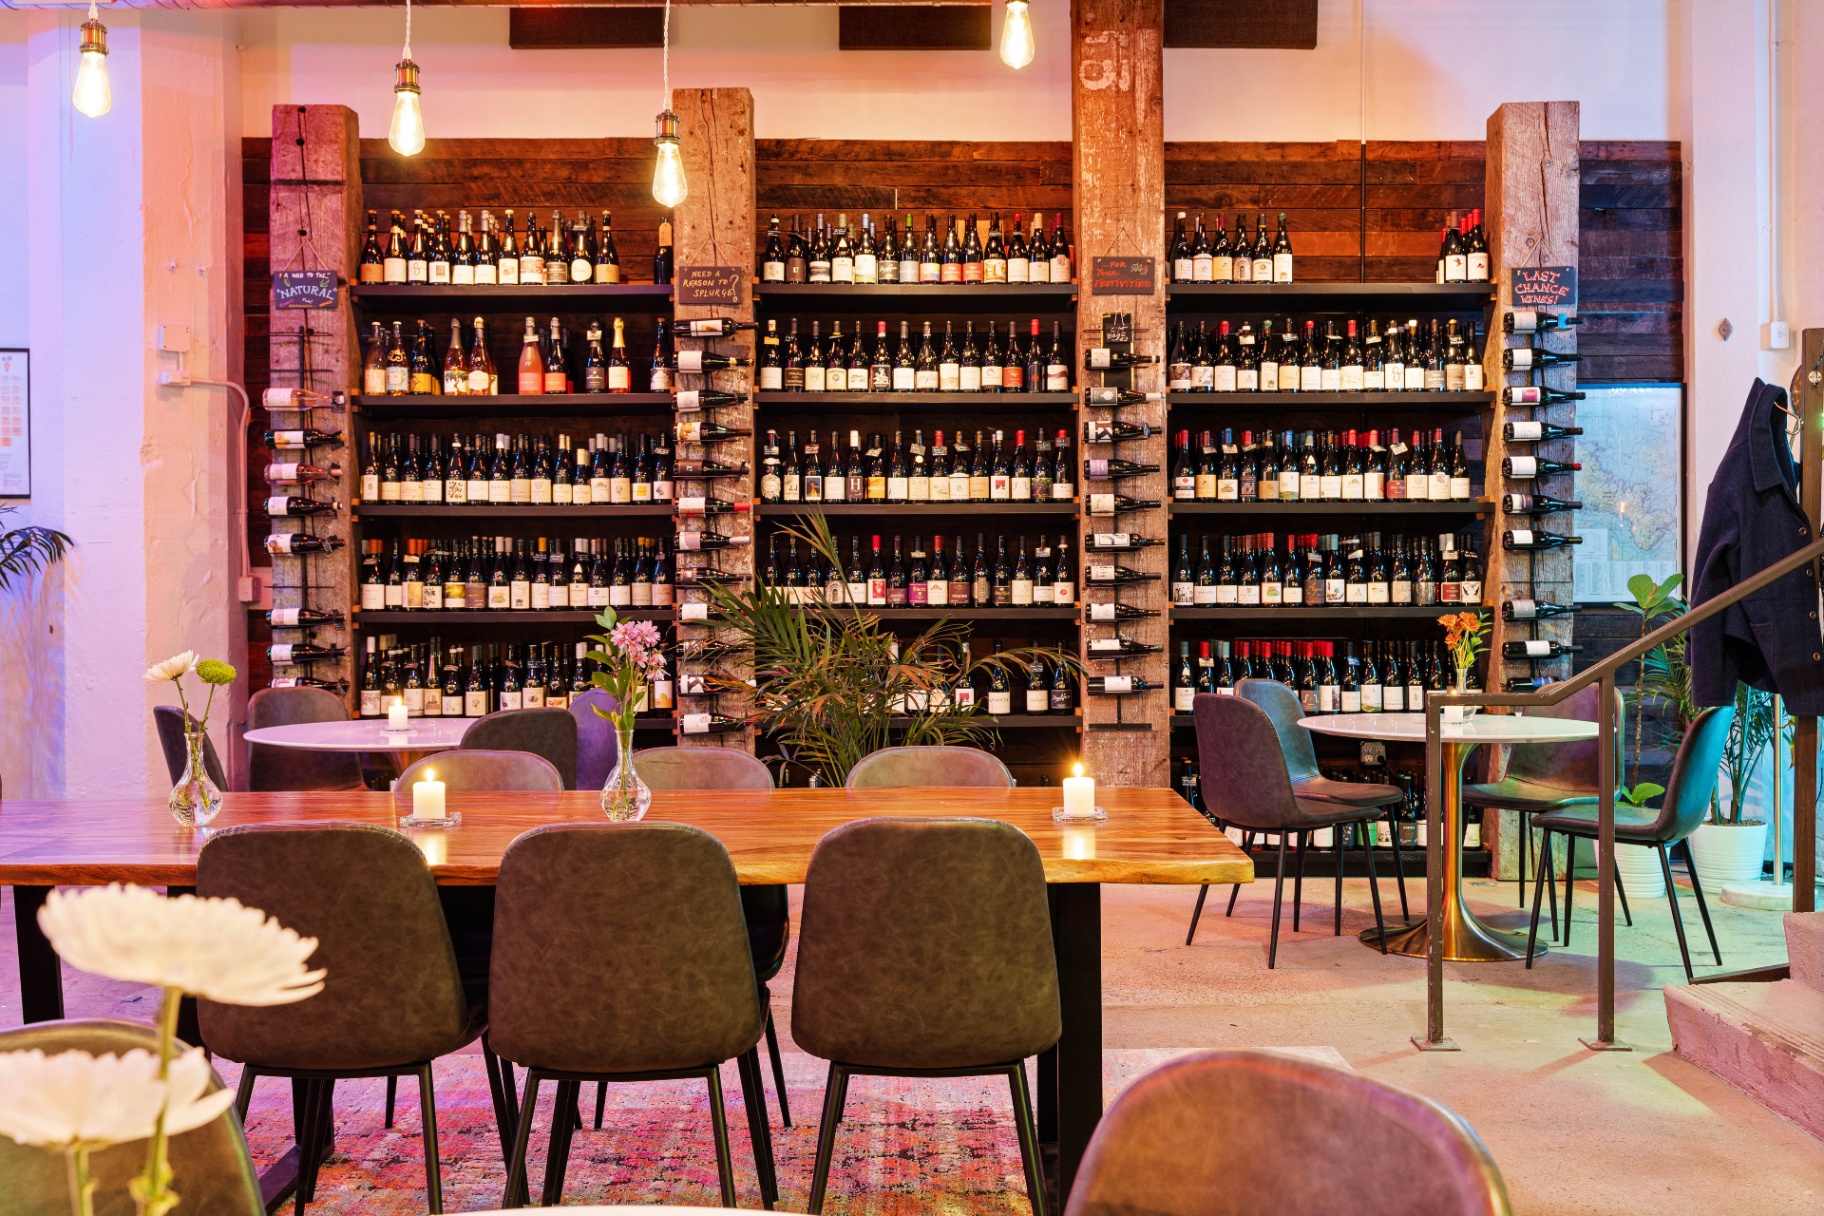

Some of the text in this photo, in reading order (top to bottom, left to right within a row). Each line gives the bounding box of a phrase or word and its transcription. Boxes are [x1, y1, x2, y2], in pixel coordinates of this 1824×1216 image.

[691, 270, 712, 278] NEED
[1522, 270, 1561, 283] LAST
[682, 279, 715, 288] REASON
[1093, 278, 1151, 288] FESTIVITIES
[1514, 282, 1570, 297] CHANCE
